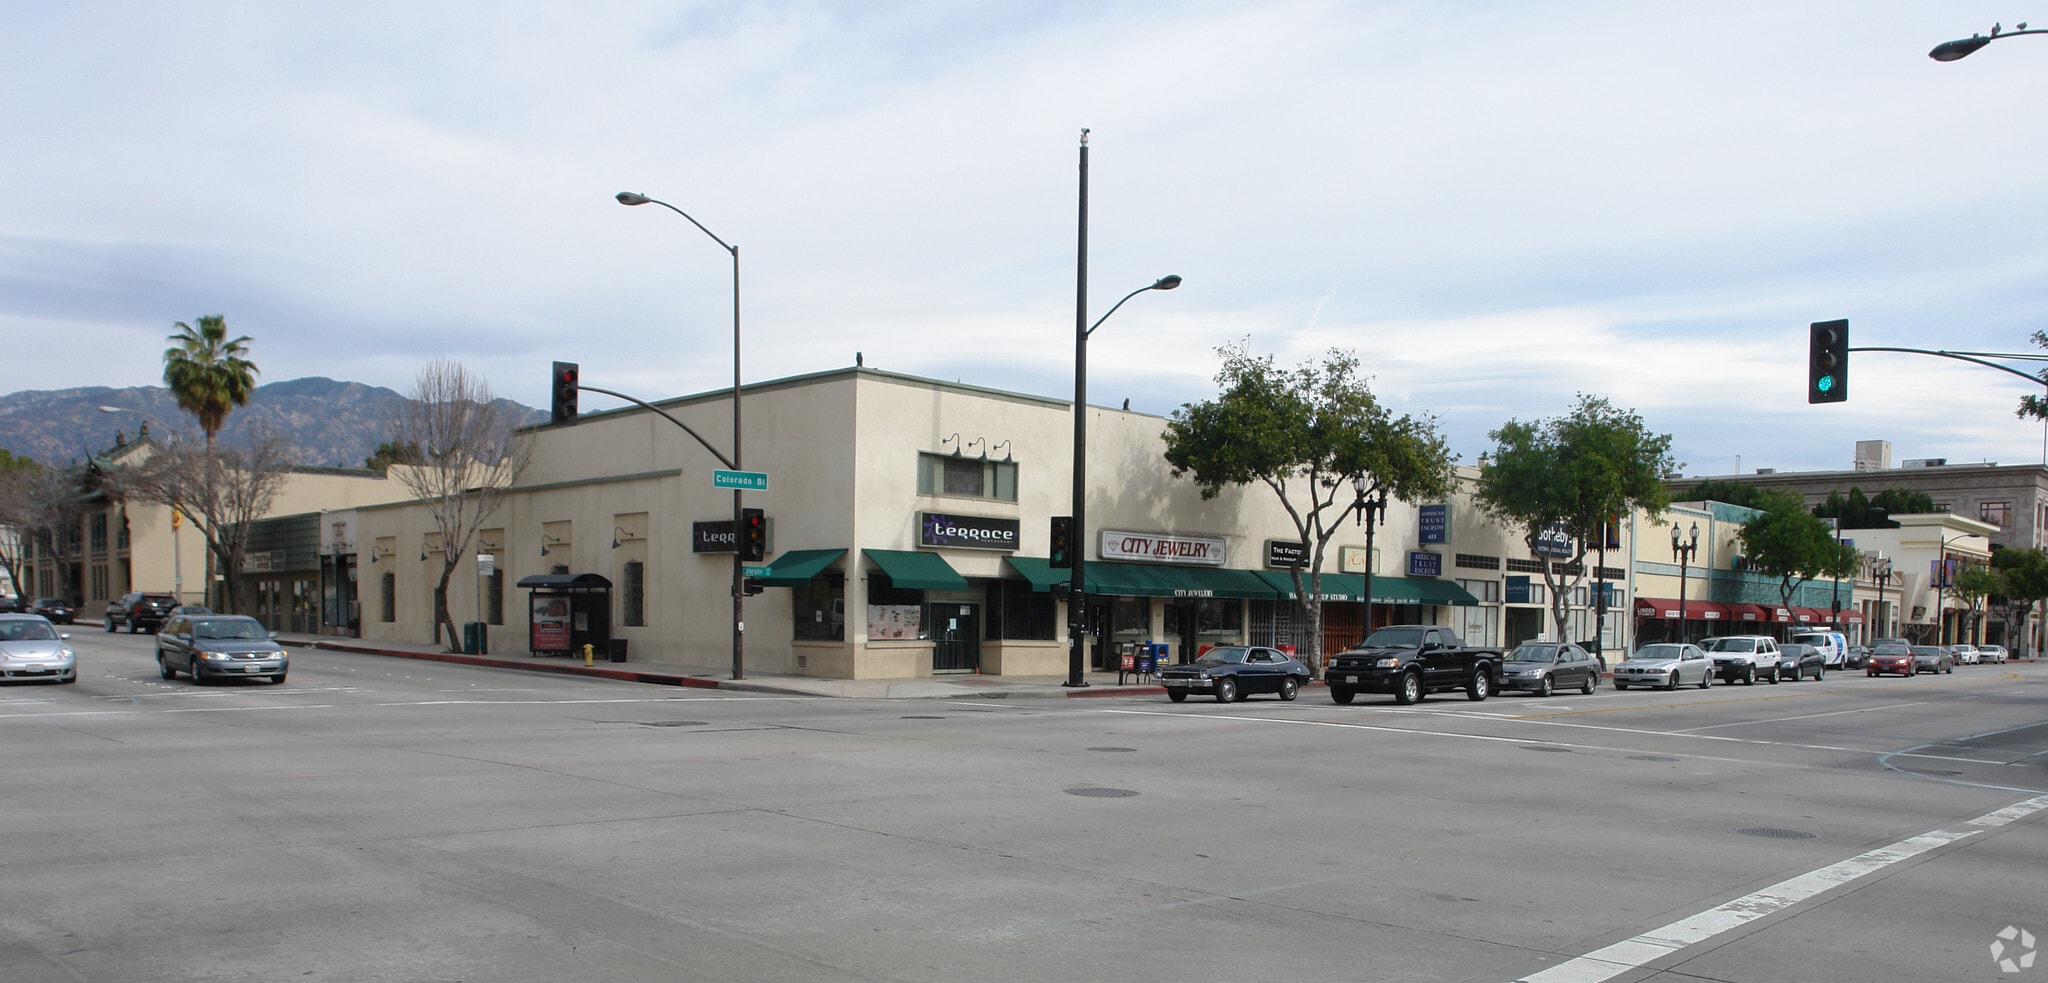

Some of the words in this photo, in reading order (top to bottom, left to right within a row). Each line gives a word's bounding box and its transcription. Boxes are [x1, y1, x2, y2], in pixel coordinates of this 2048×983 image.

[716, 475, 752, 485] Colorado
[703, 530, 735, 543] terr
[935, 522, 1013, 540] terrace
[1121, 537, 1153, 554] CITY
[1153, 540, 1210, 557] JEWELRY
